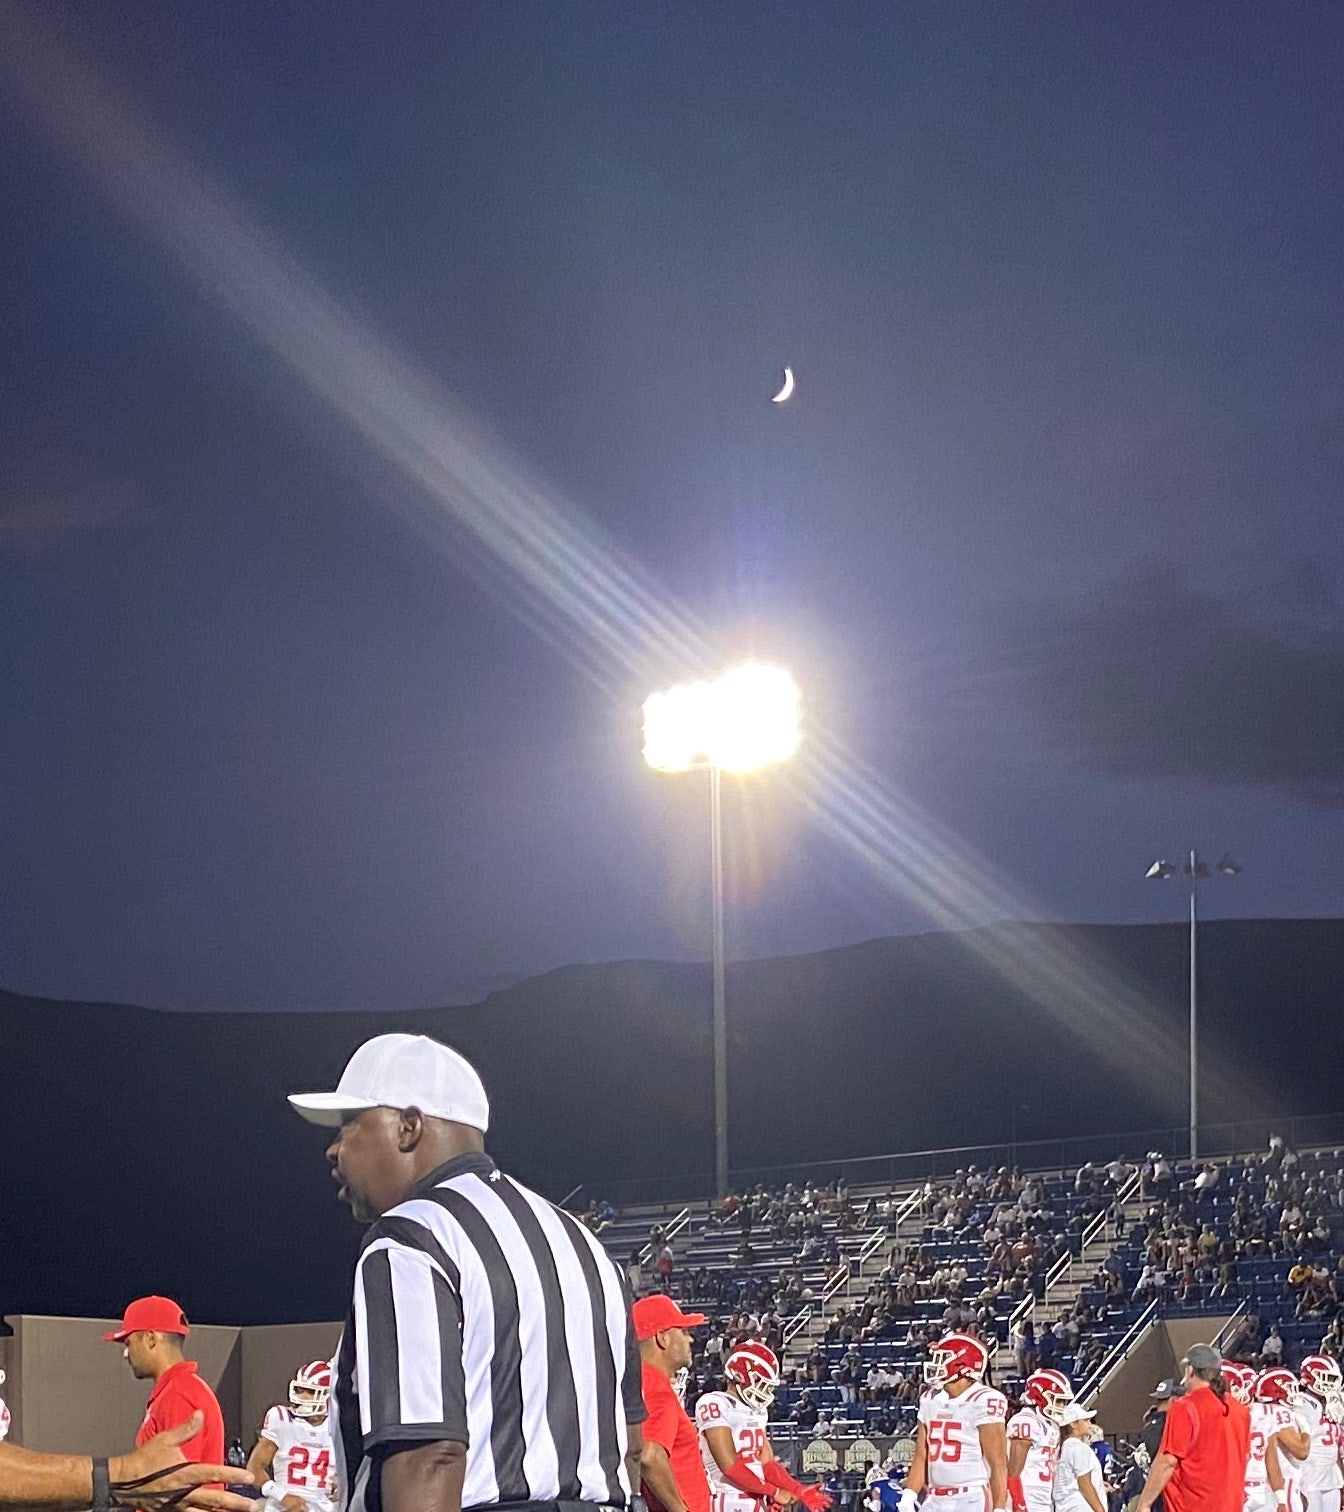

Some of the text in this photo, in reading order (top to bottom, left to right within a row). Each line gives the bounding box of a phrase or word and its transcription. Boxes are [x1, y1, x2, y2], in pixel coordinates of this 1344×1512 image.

[699, 1402, 722, 1422] 28
[987, 1398, 1006, 1417] 55
[1011, 1423, 1031, 1439] 30
[928, 1420, 962, 1463] 55
[287, 1446, 330, 1489] 24
